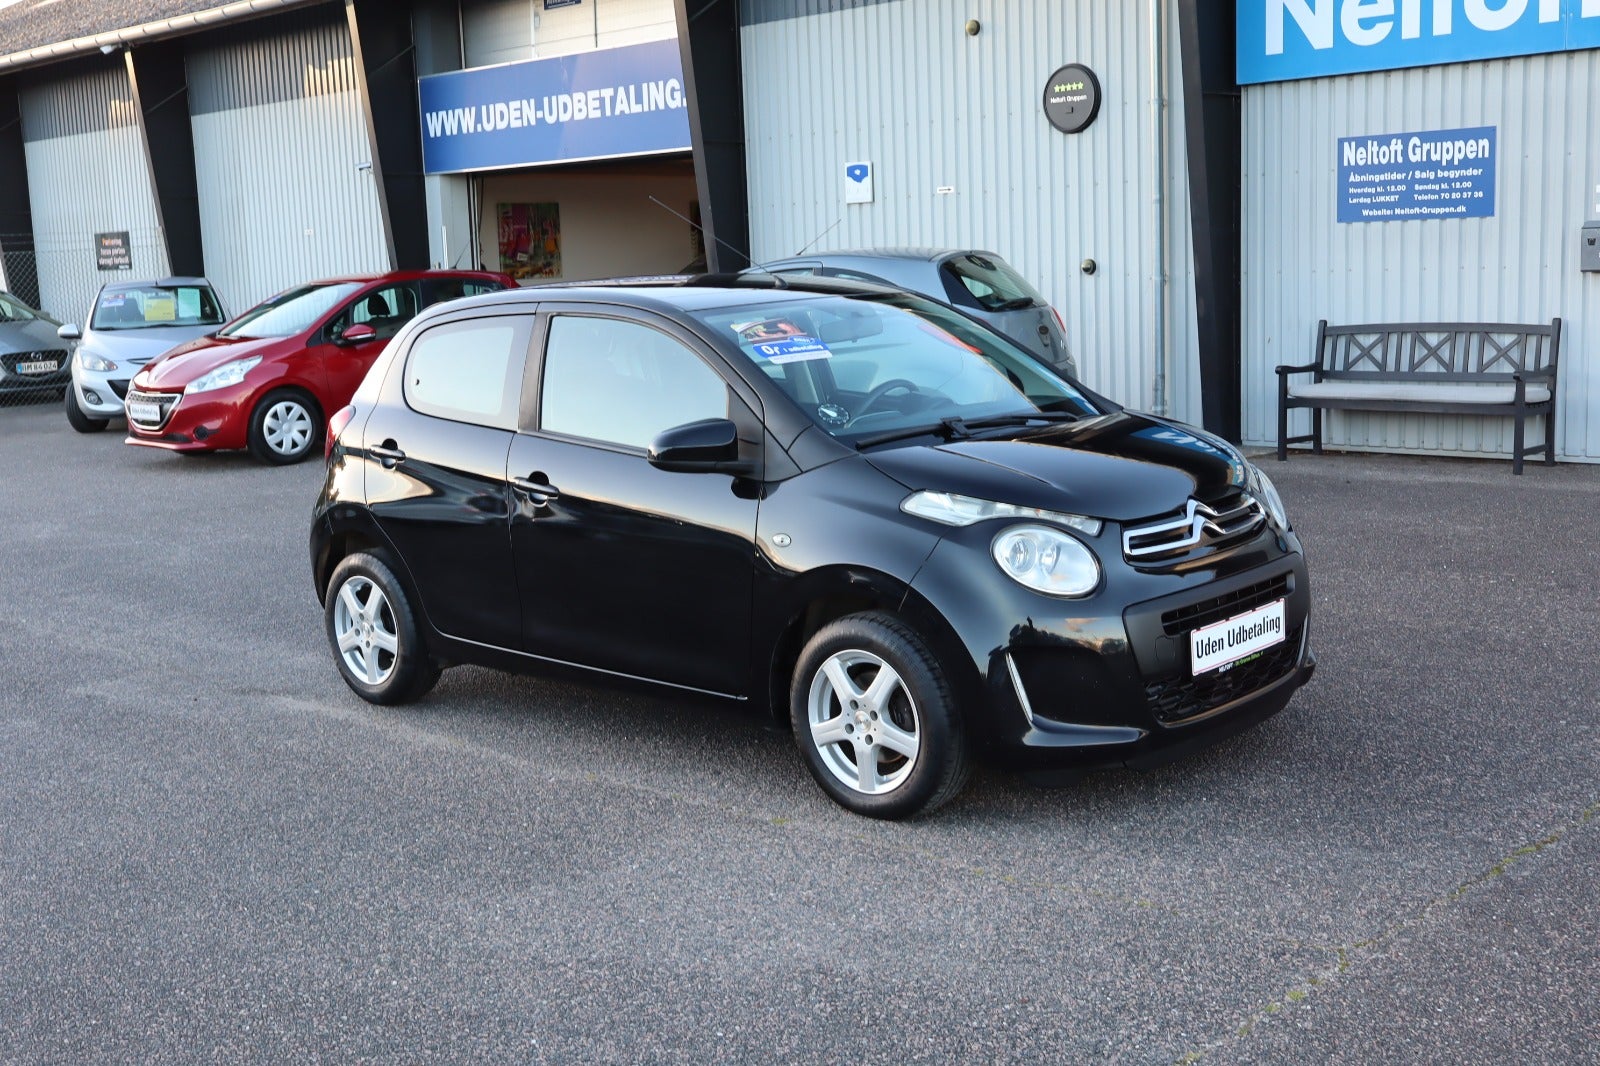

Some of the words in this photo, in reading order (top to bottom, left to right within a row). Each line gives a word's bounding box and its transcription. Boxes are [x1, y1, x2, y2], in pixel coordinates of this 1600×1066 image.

[426, 78, 687, 138] WWW.UDEN-UDBETALING.
[1343, 138, 1403, 167] Neltoft
[1407, 136, 1490, 166] Gruppen
[1349, 171, 1406, 183] Åbningstider
[1414, 169, 1435, 180] Salg
[1437, 167, 1483, 179] begynder
[1362, 208, 1393, 216] Website:
[1394, 205, 1467, 215] Neltoft-Gruppen.dk
[1196, 637, 1224, 659] Uden
[1228, 615, 1280, 647] Udbetaling
